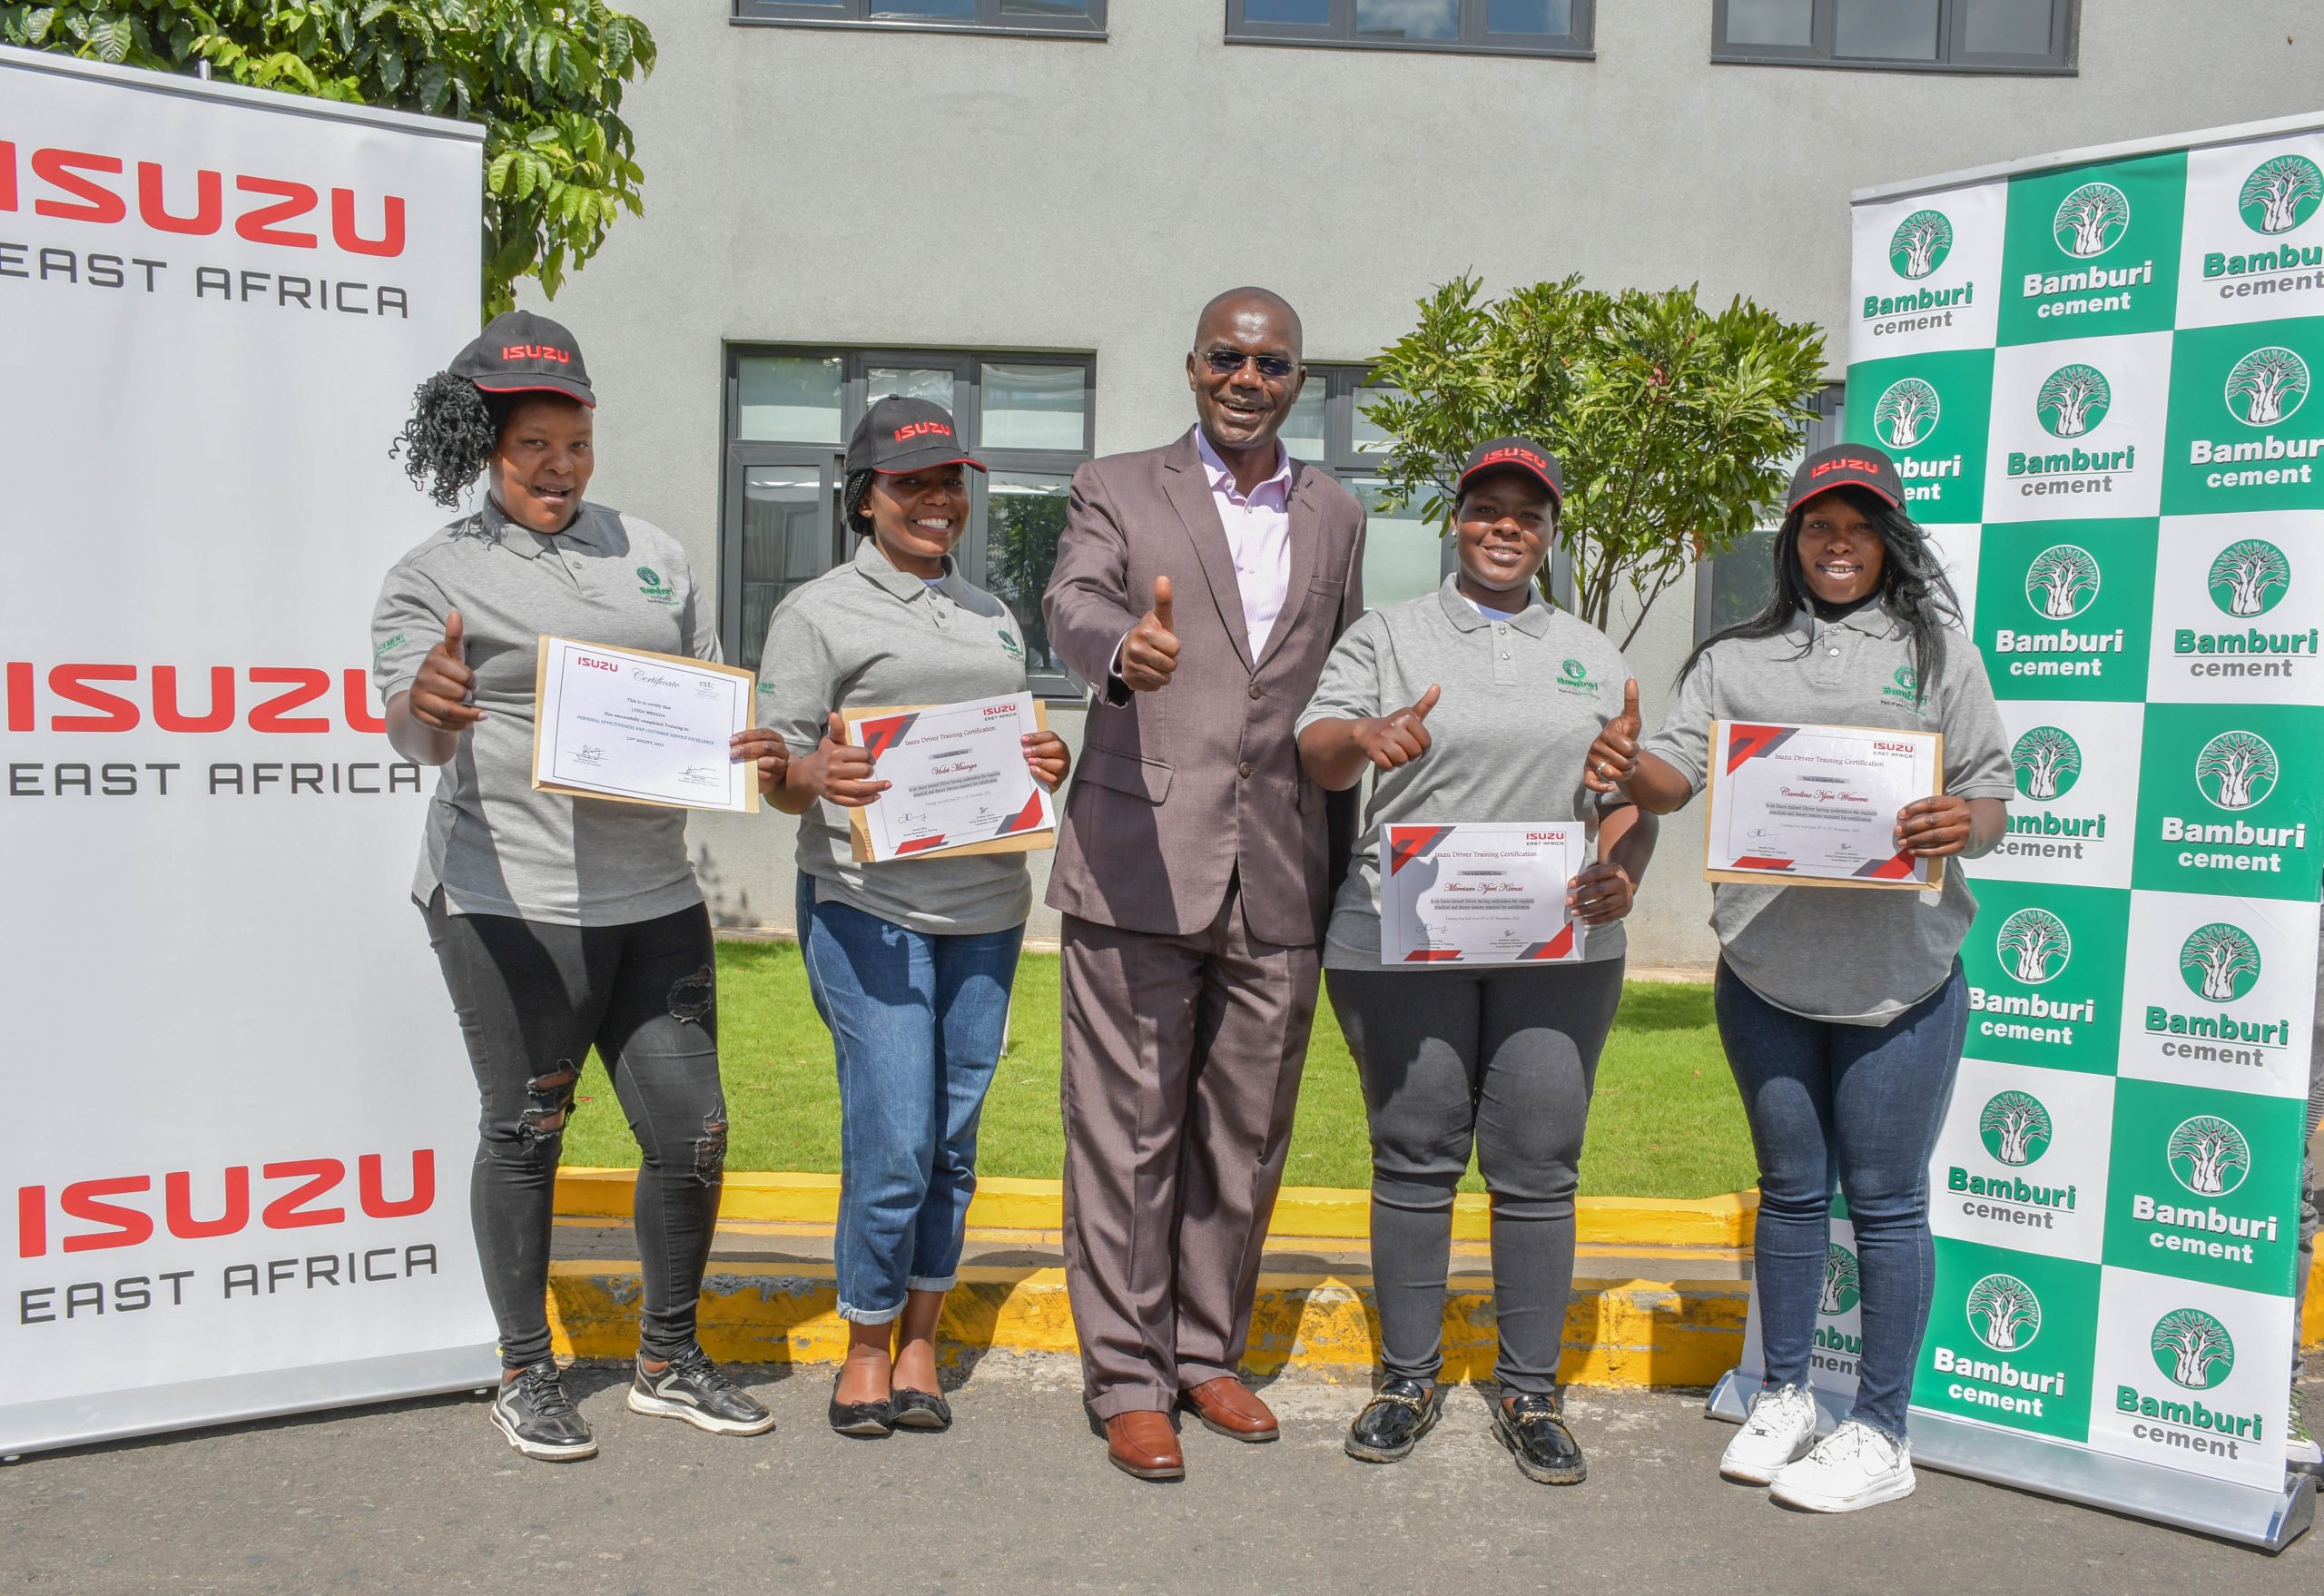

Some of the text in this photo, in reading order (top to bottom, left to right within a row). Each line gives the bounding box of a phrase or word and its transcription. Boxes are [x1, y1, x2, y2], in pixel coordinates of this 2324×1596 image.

[0, 141, 406, 258] ISUZU
[2203, 243, 2324, 278] Bambu
[0, 242, 409, 319] EAST AFRICA
[2022, 261, 2152, 299] Bamburi
[1863, 281, 1973, 318] Bamburi
[2037, 292, 2131, 319] cement
[1873, 311, 1953, 337] cement
[503, 344, 570, 364] ISUZU
[894, 421, 952, 443] ISUZU
[1482, 448, 1547, 469] ISUZU
[2007, 445, 2135, 476] Bamburi
[2190, 435, 2324, 465] Bambur
[1810, 458, 1879, 479] ISUZU
[2206, 464, 2312, 488] cement
[2021, 476, 2112, 497] cement
[1995, 628, 2124, 655] Bamburi
[2174, 628, 2319, 655] Bamburi
[577, 656, 618, 672] ISUZU
[2009, 658, 2102, 676] cement
[2191, 659, 2293, 678] cement
[631, 667, 680, 689] Certificate
[983, 704, 1017, 715] ISUZU
[921, 734, 939, 744] Driver
[940, 731, 963, 740] Training
[963, 725, 996, 736] Certification
[1873, 742, 1914, 753] ISUZU
[1845, 759, 1884, 767] Certification
[9, 763, 422, 796] EAST AFRICA
[1780, 787, 1813, 799] Caroline
[2161, 817, 2306, 850] Bamburi
[2179, 850, 2281, 873] cement
[1967, 987, 2094, 1024] Bamburi
[1980, 1020, 2073, 1045] cement
[2144, 1005, 2290, 1046] Bamburi
[2162, 1041, 2264, 1068] cement
[1947, 1166, 2077, 1210] Bamburi
[19, 1148, 435, 1258] ISUZU
[1962, 1200, 2053, 1229] cement
[2132, 1195, 2279, 1243] Bamburi
[2149, 1231, 2253, 1264] cement
[20, 1244, 438, 1325] EAST AFRICA
[1934, 1347, 2065, 1398] Bamburi
[1947, 1383, 2043, 1418] cement
[2115, 1384, 2262, 1442] Bamburi
[2132, 1420, 2239, 1461] cement
